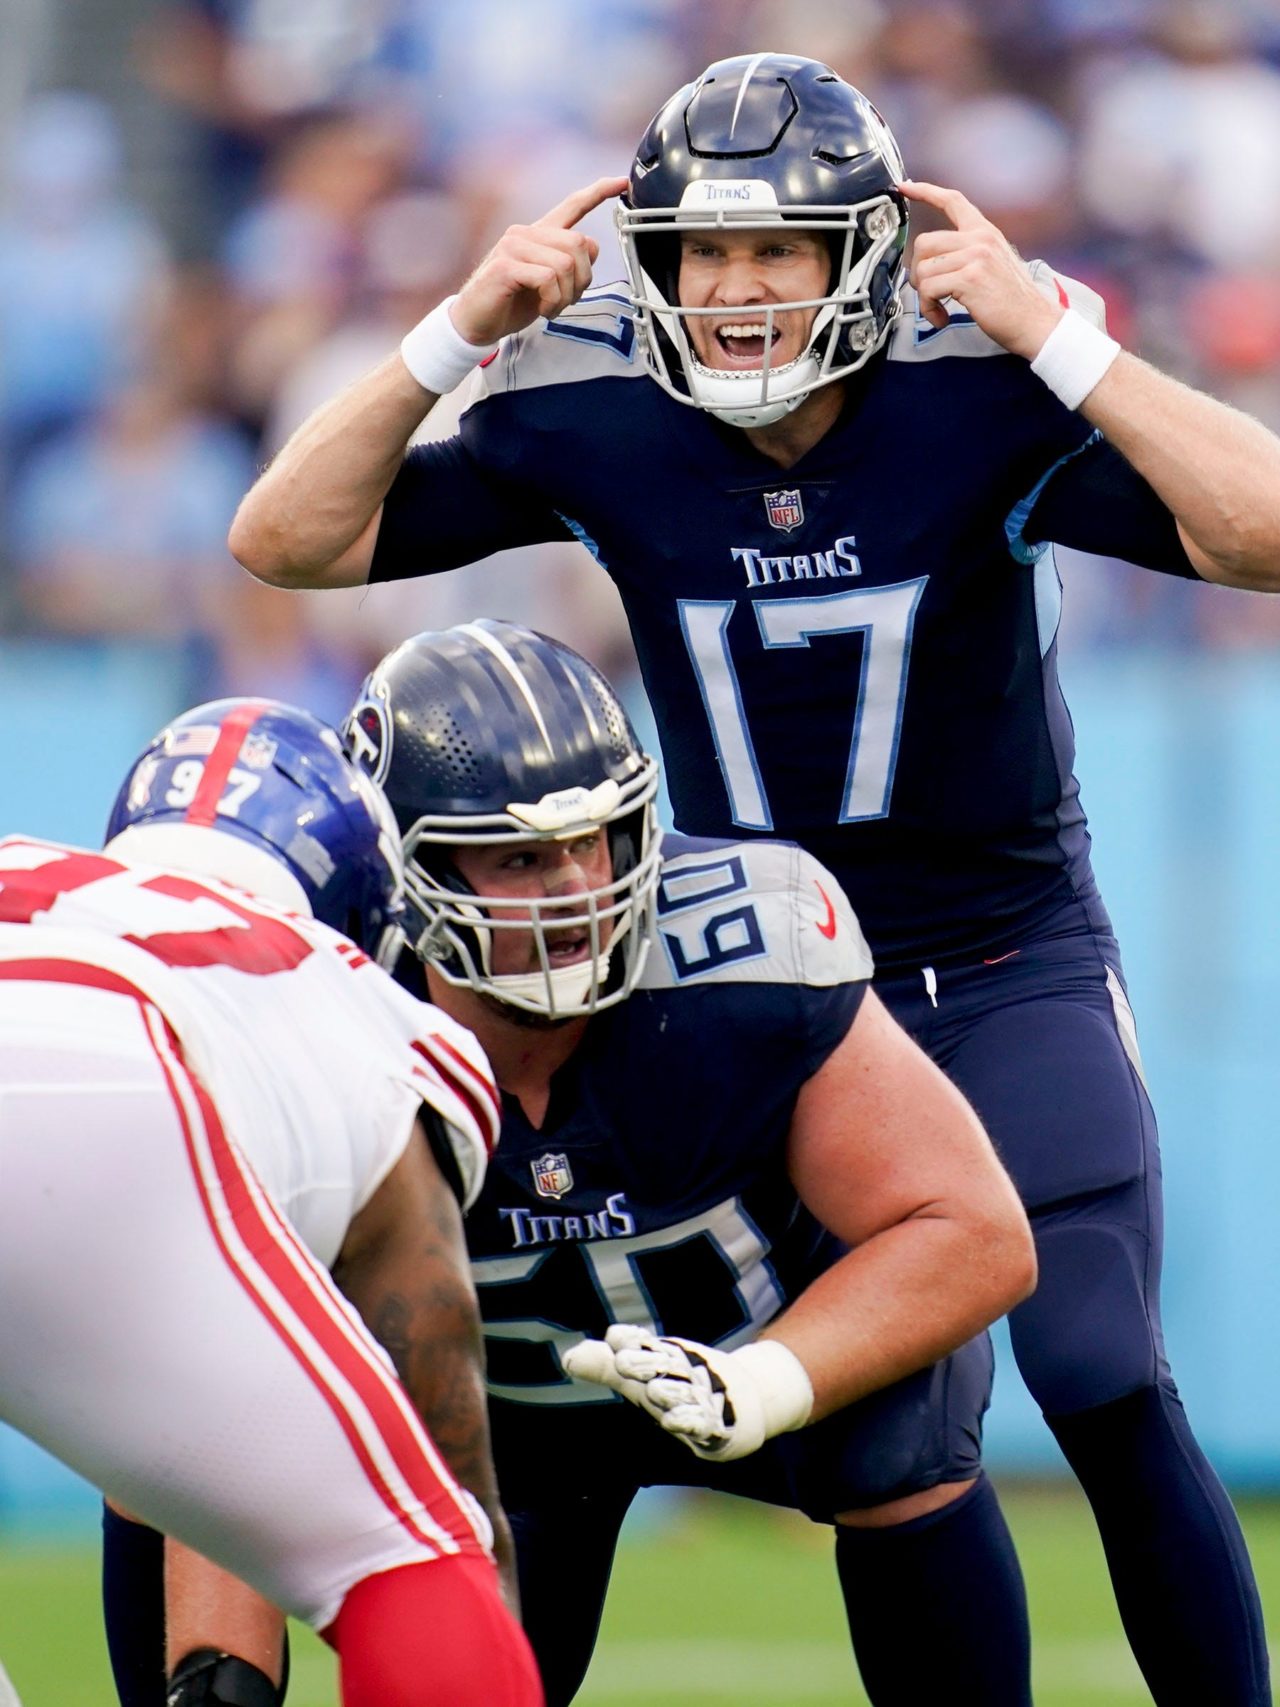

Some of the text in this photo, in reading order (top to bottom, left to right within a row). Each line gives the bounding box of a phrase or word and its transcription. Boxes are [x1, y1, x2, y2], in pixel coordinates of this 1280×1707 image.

[704, 184, 751, 200] TITANS
[771, 507, 799, 525] NFL
[730, 535, 862, 588] TITANS
[675, 574, 930, 832] 17
[165, 760, 262, 818] 97
[656, 852, 770, 985] 60
[499, 1193, 636, 1248] TITANS
